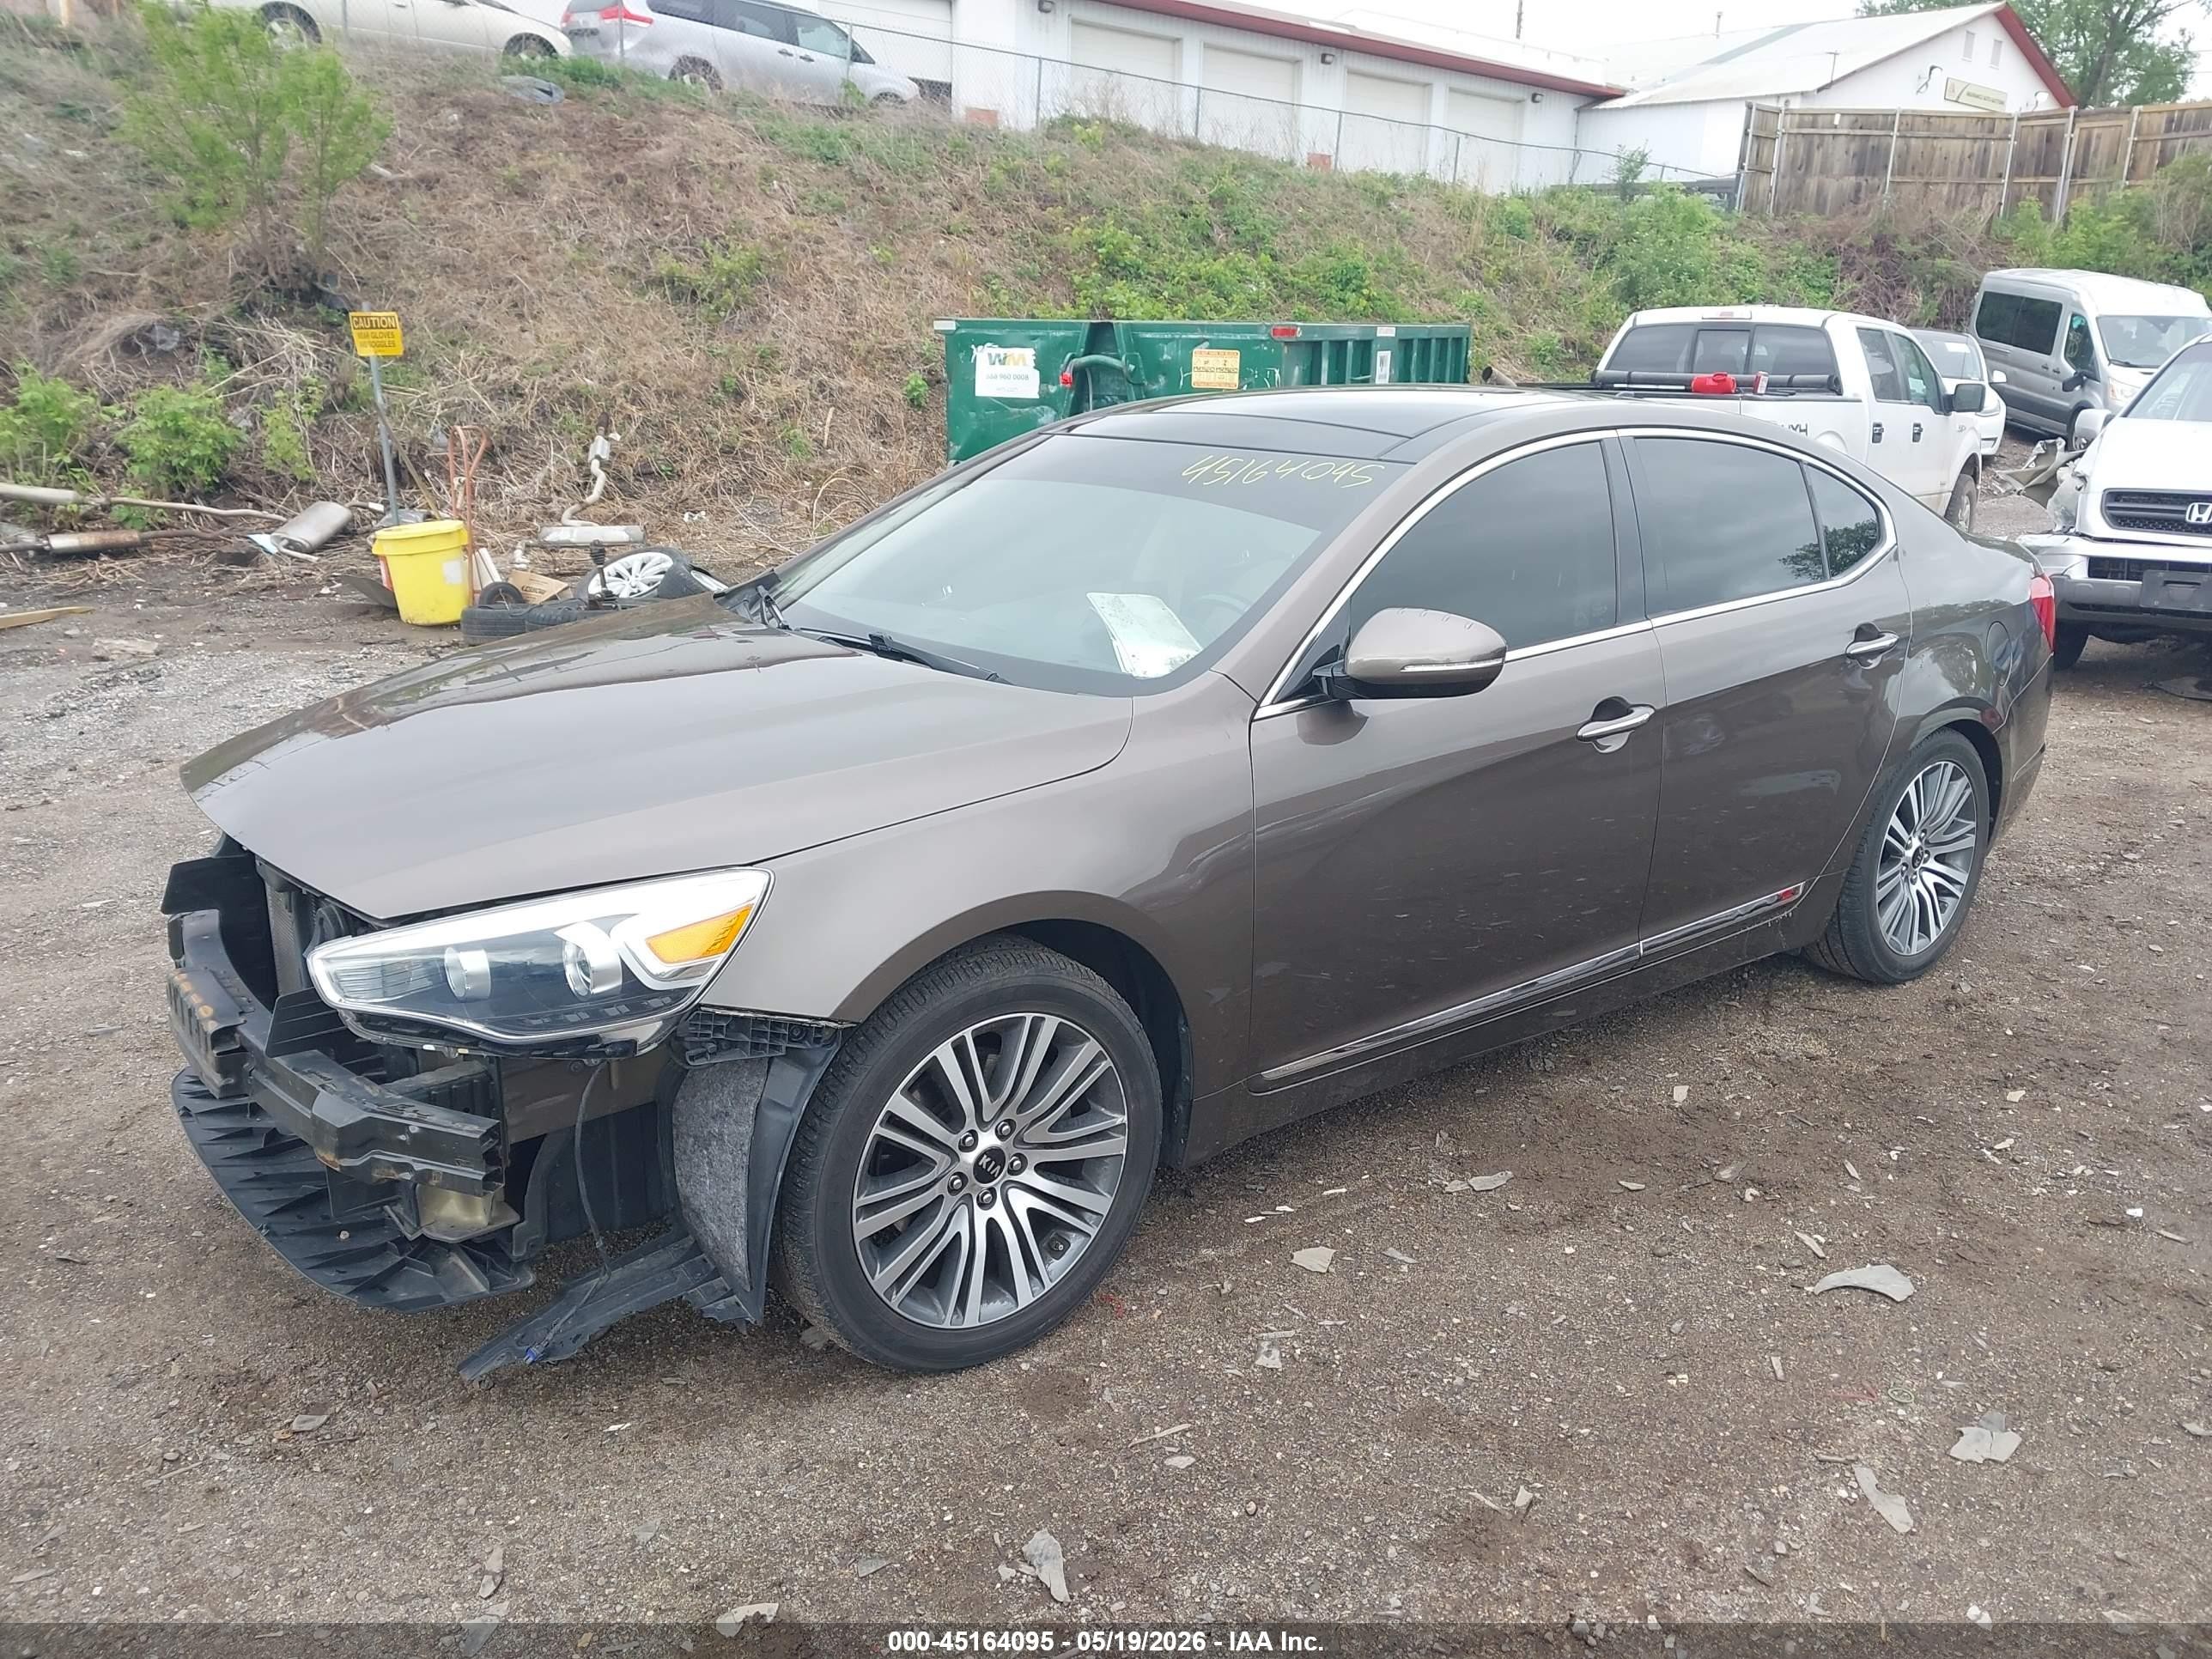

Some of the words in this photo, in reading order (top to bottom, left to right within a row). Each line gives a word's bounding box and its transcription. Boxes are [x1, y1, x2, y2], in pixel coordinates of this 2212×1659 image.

[352, 316, 396, 329] CAUTION
[988, 352, 1027, 367] WM
[979, 1154, 1001, 1177] KIA
